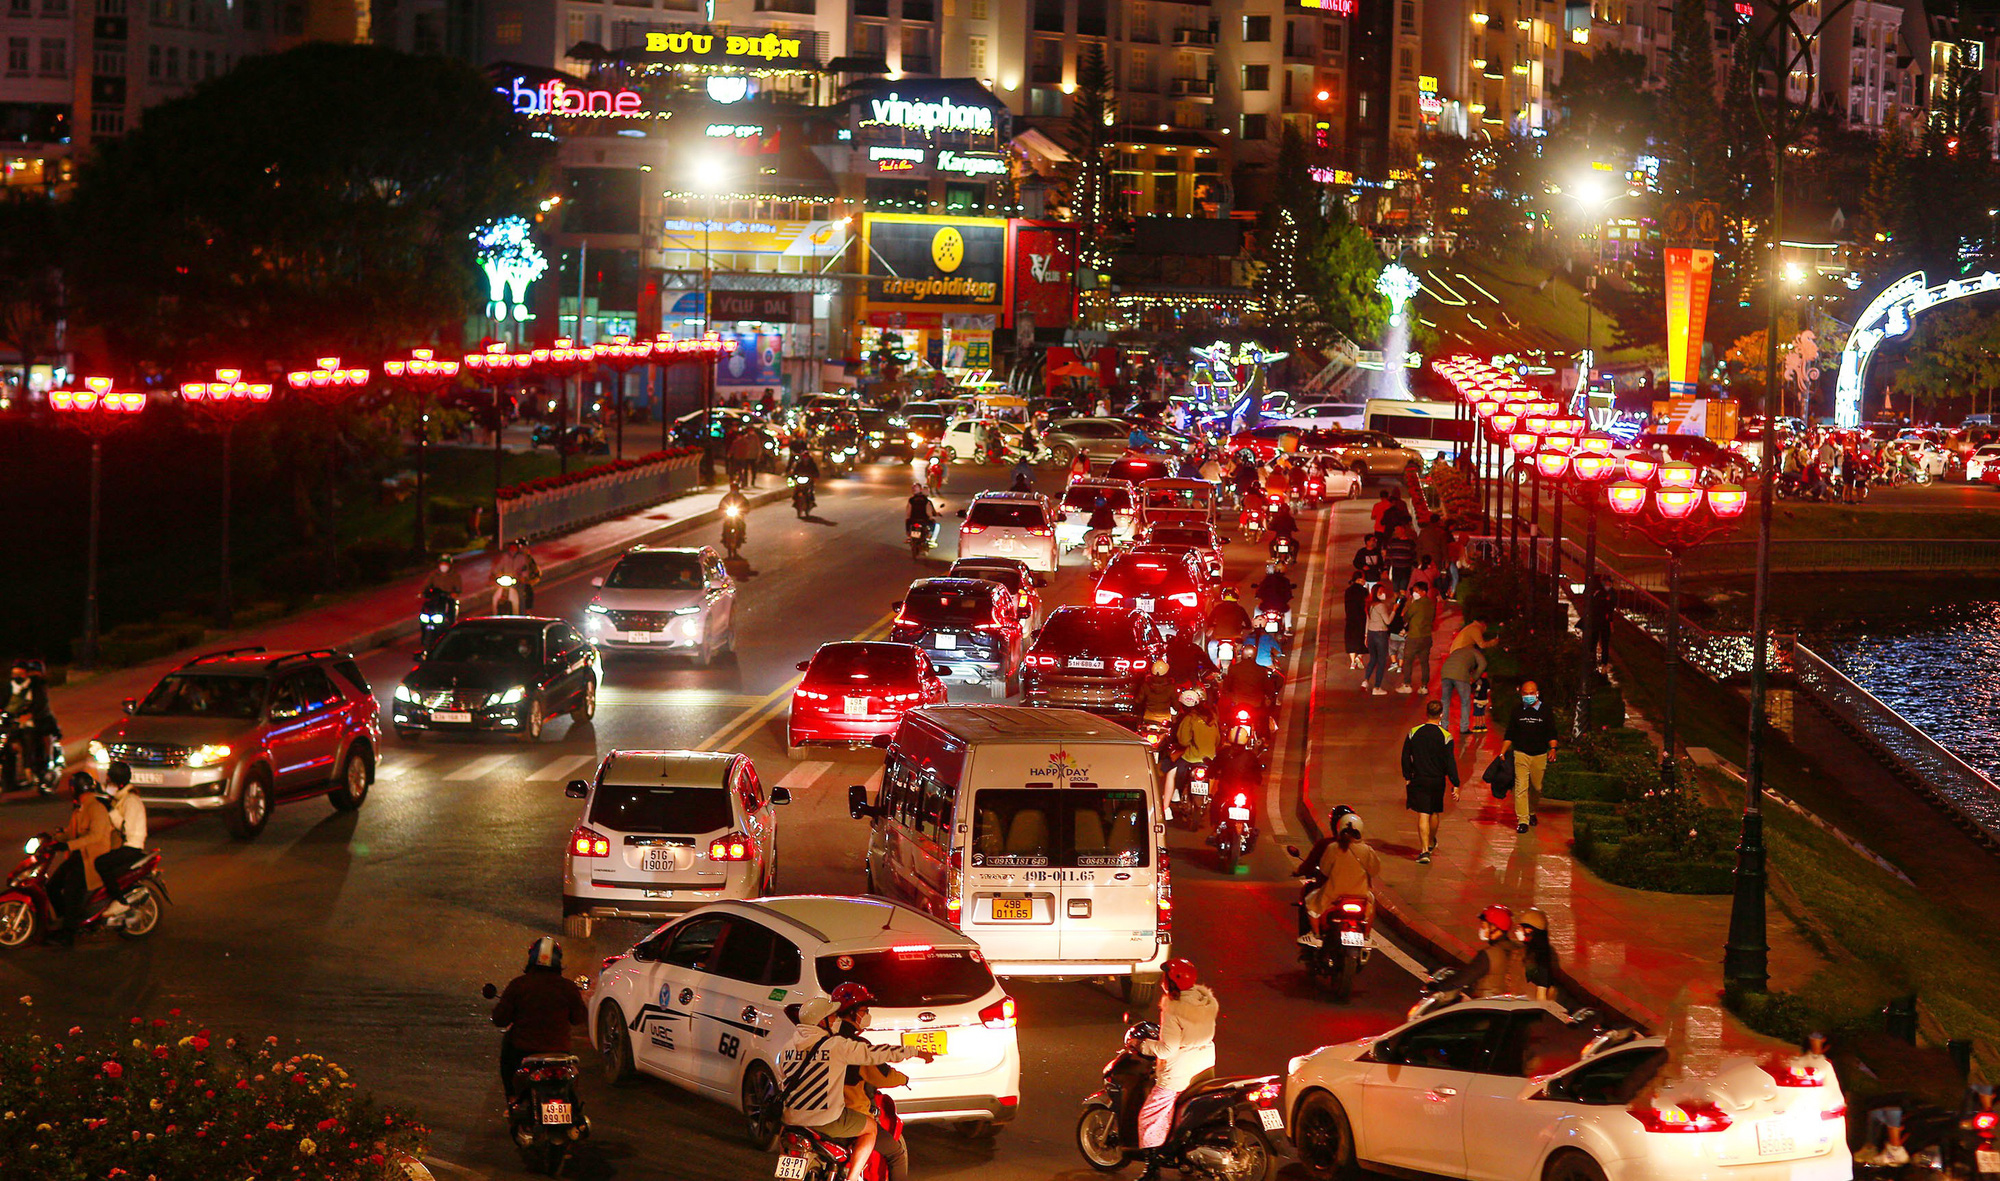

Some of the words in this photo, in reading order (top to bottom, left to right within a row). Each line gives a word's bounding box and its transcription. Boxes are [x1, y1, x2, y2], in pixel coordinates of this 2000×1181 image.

[645, 31, 713, 54] BƯU
[725, 33, 801, 61] ĐIỆN
[496, 77, 642, 115] bifone
[871, 92, 992, 131] vinaphone
[883, 276, 997, 302] thegioididong
[1066, 768, 1089, 776] DAY
[650, 850, 668, 860] 51G
[1022, 871, 1095, 882] 49B-011.65
[1003, 900, 1021, 909] 49B
[996, 909, 1029, 918] 011.65
[916, 1032, 935, 1043] 49E
[718, 1032, 740, 1059] 68
[543, 1113, 571, 1122] 899.10
[781, 1156, 804, 1169] 49-P1
[779, 1166, 801, 1179] 3614
